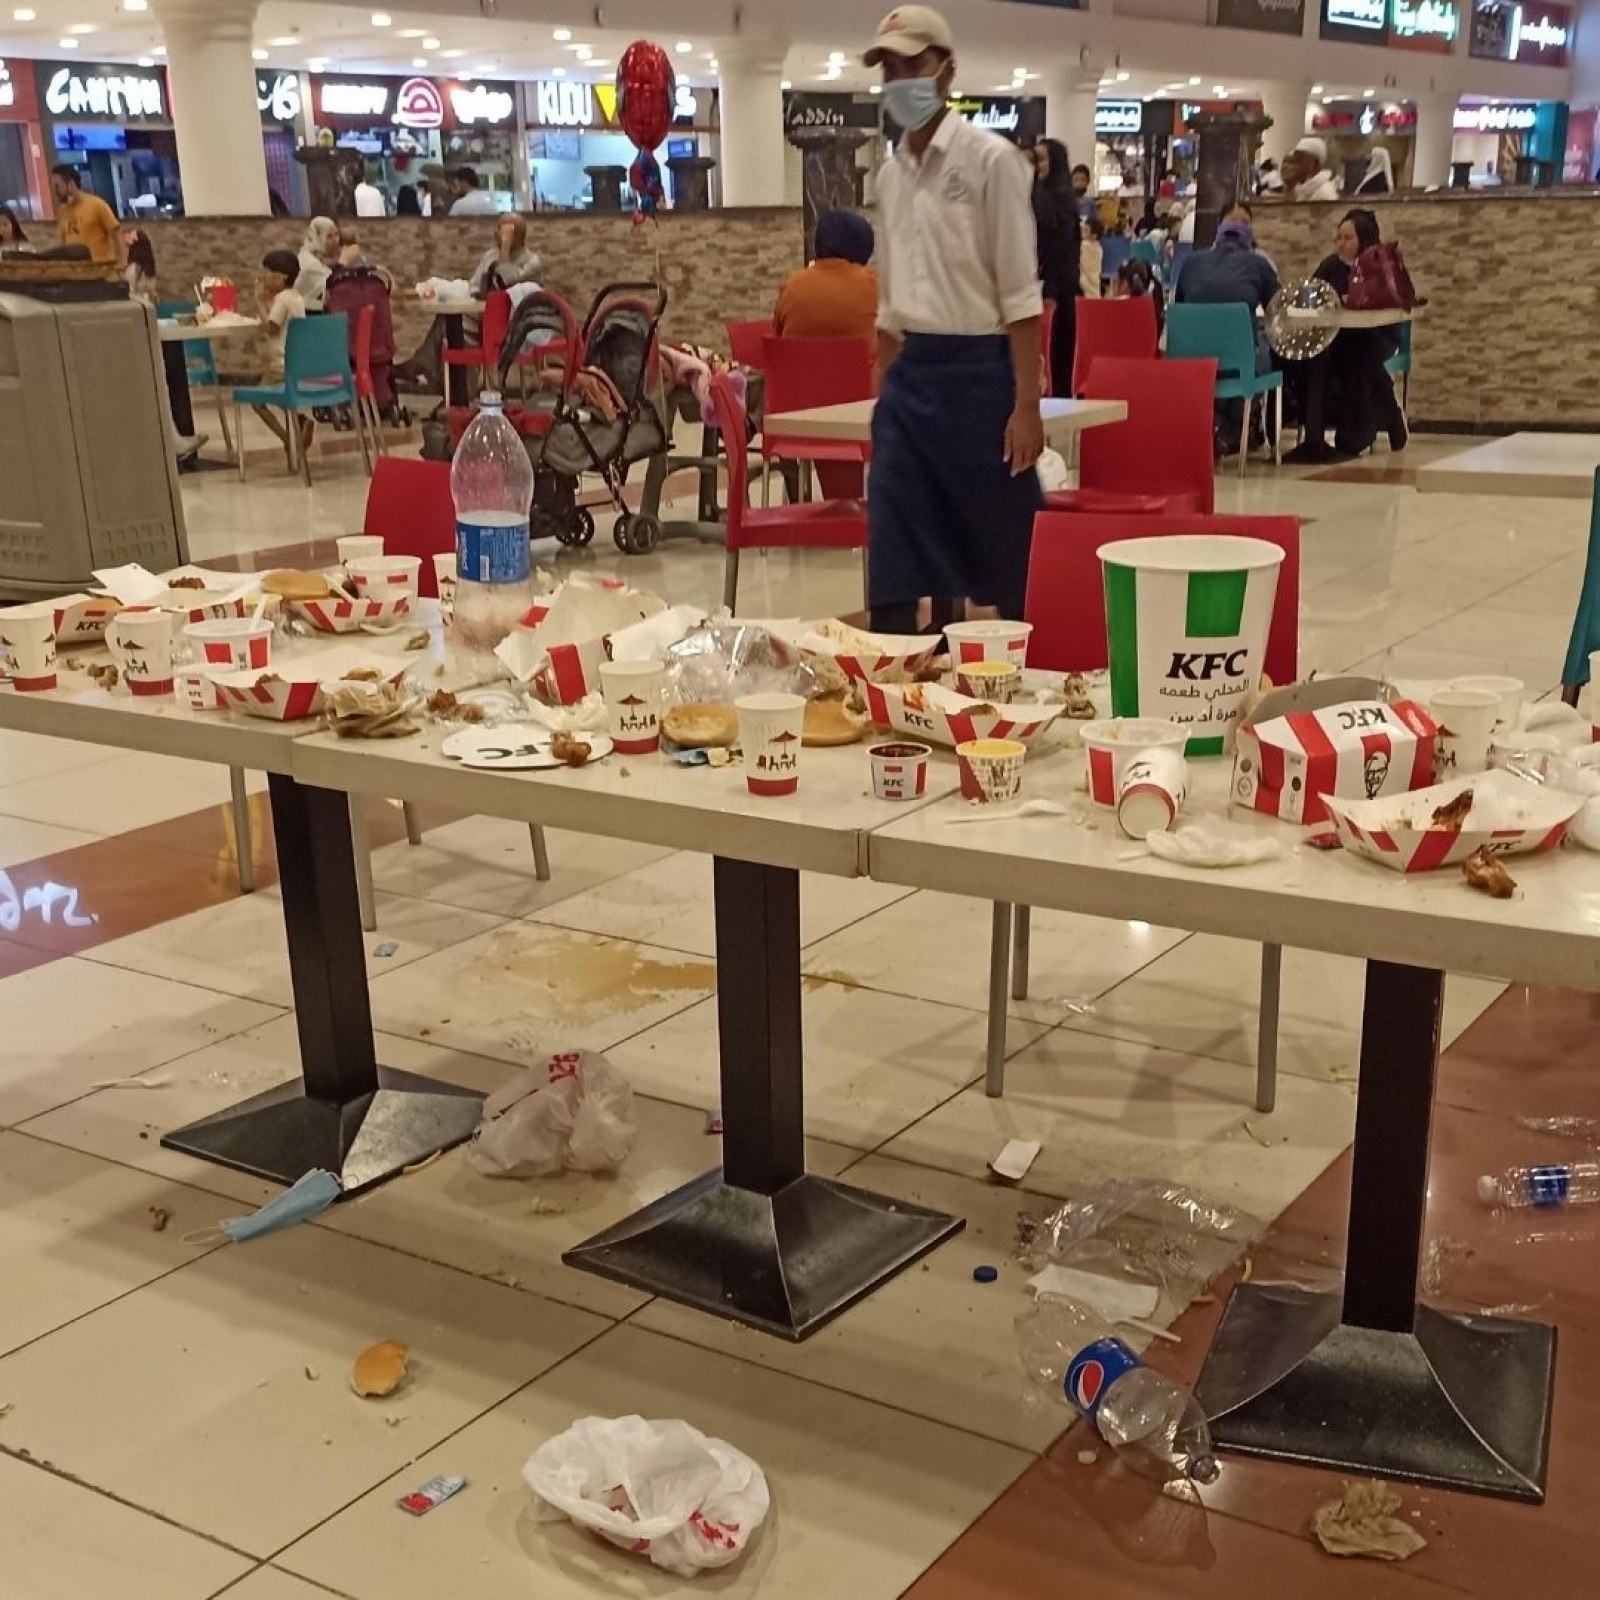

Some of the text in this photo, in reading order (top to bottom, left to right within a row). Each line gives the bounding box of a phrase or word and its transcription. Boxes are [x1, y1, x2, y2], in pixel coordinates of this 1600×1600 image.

[75, 620, 108, 631] KFC
[1165, 648, 1248, 680] KFC
[903, 711, 934, 730] KFC
[1337, 708, 1388, 730] KFC
[477, 741, 554, 759] FC
[883, 778, 905, 788] KFC
